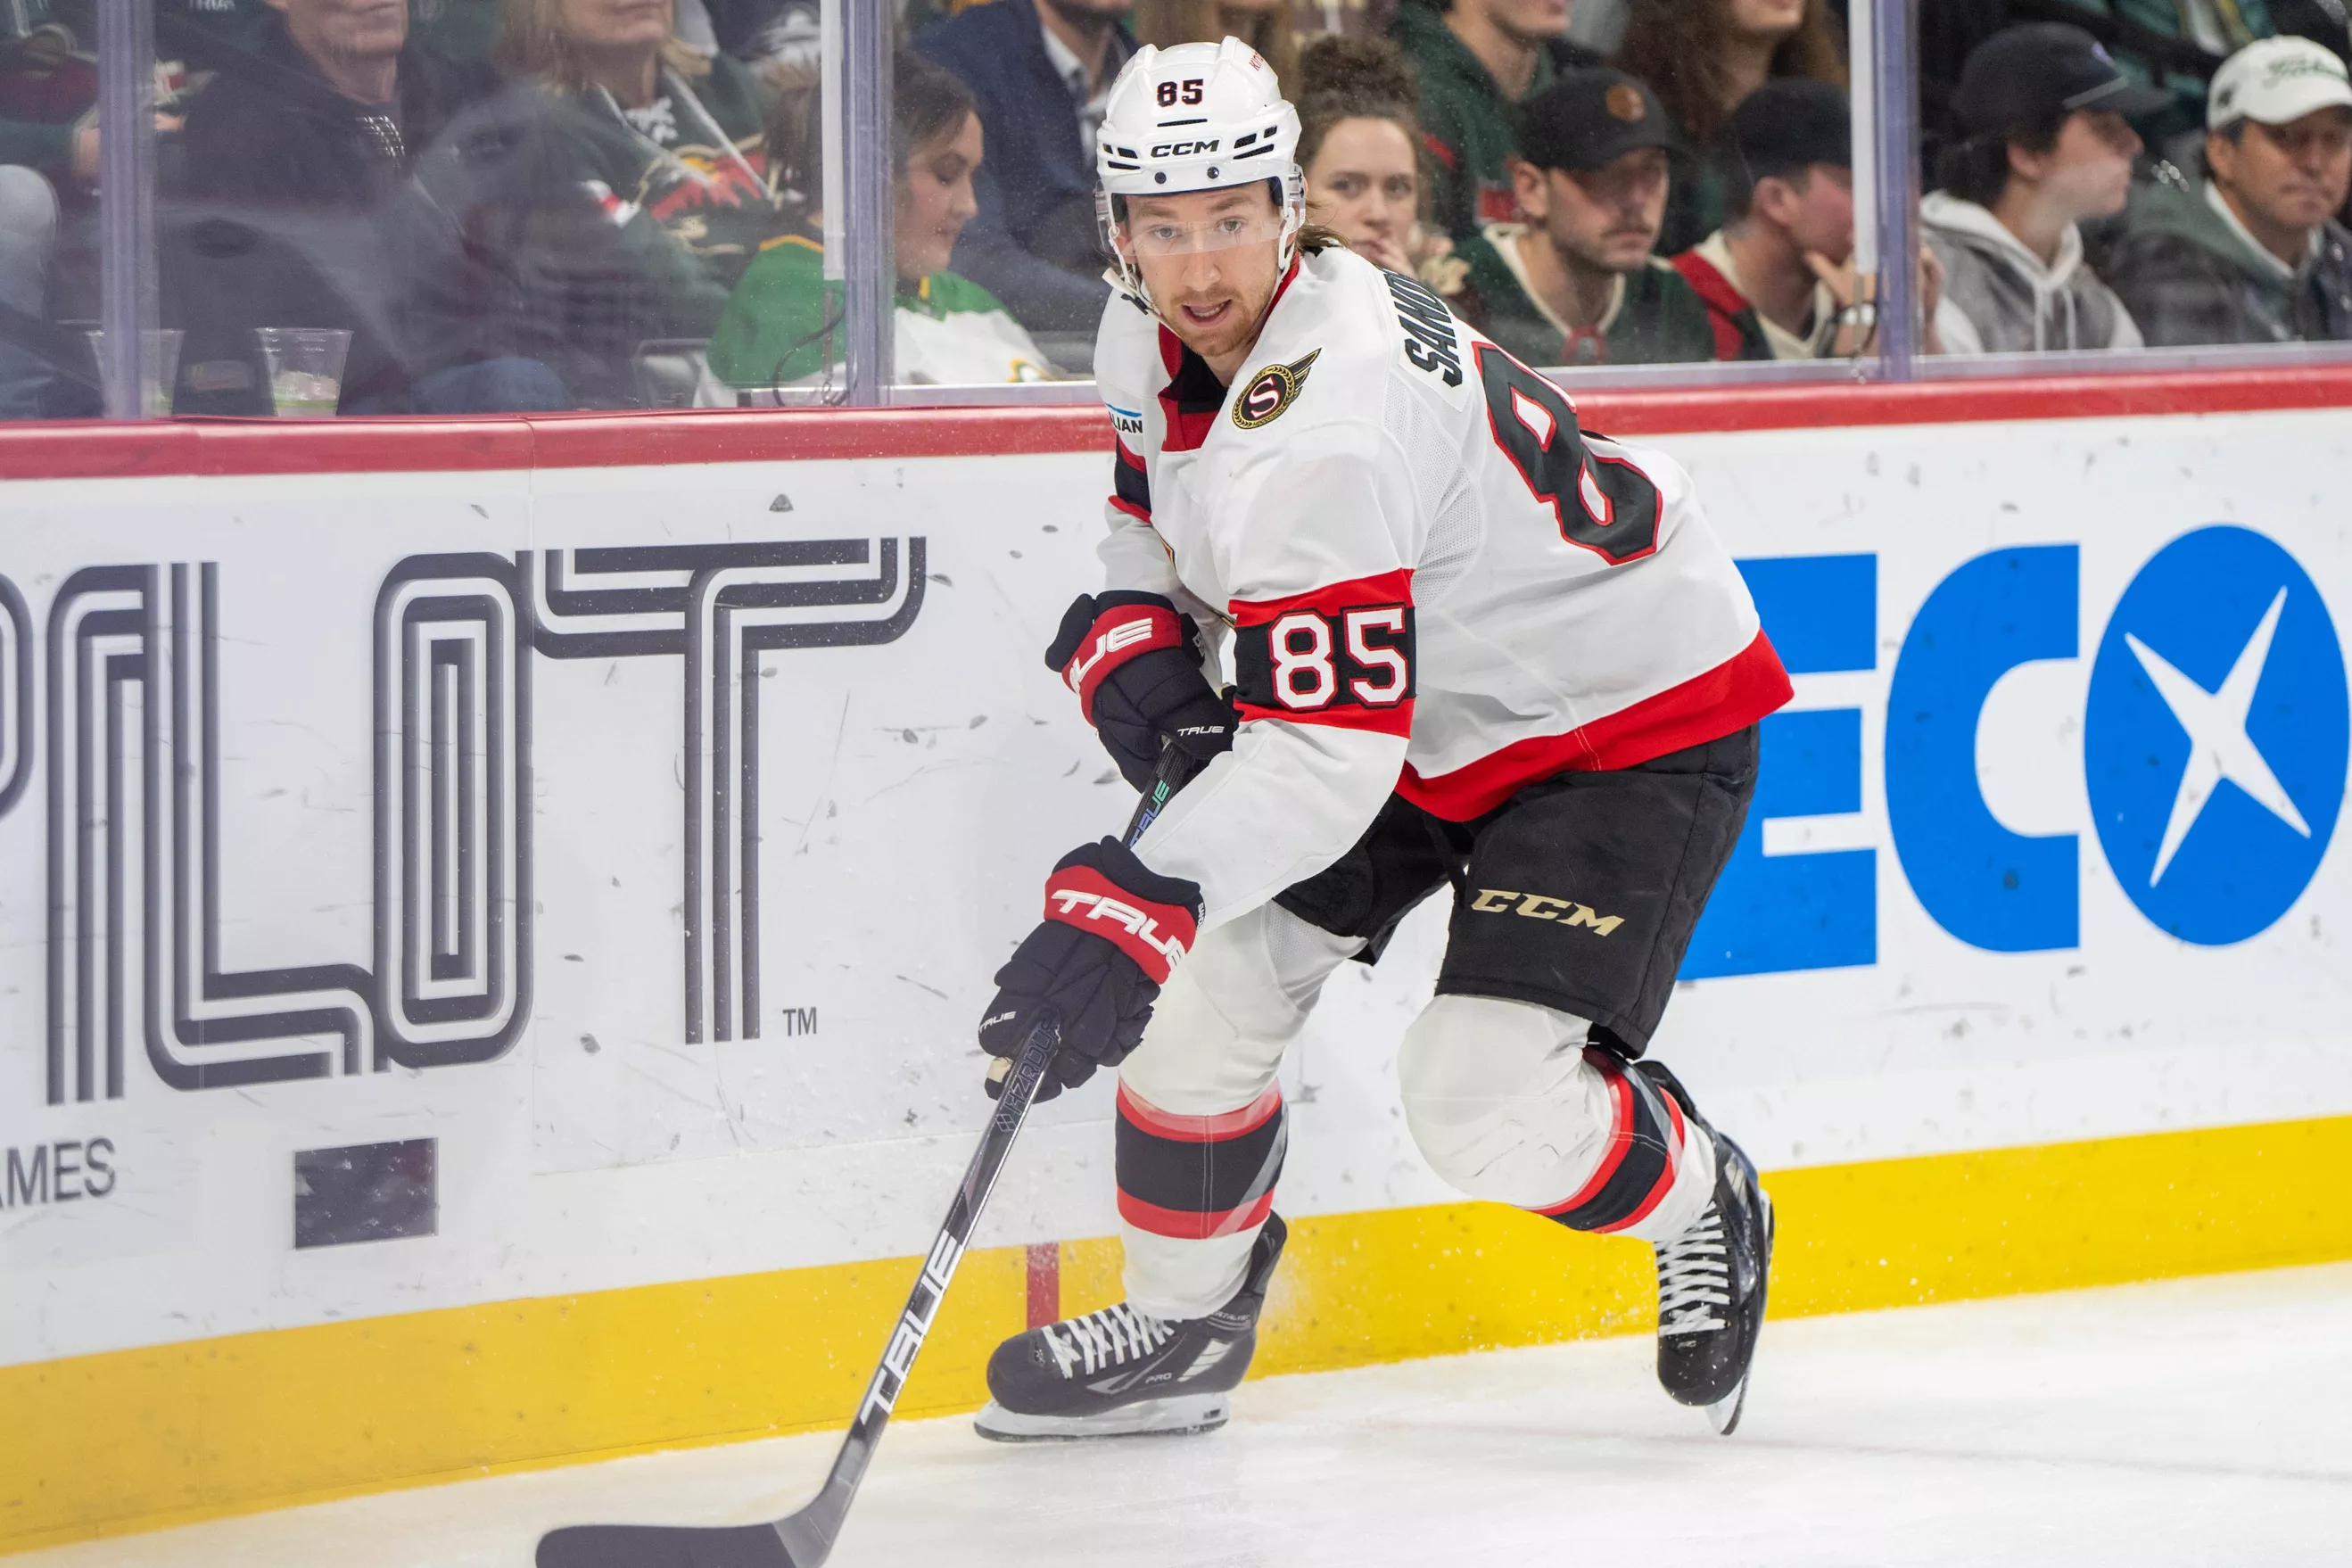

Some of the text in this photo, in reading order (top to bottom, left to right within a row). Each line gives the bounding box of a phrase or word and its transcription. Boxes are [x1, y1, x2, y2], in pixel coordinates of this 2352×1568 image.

[1157, 78, 1204, 108] 85
[1150, 139, 1219, 158] CCM
[1375, 265, 1463, 388] SAND
[1471, 340, 1663, 566] 8
[1267, 601, 1409, 712] 85
[1176, 725, 1225, 737] TRUE
[1052, 889, 1186, 967] TRUE
[1472, 889, 1625, 937] CCM
[782, 1006, 817, 1036] TM
[978, 1011, 1016, 1034] TRUE
[0, 1135, 117, 1209] MES
[859, 1228, 965, 1426] TRUE
